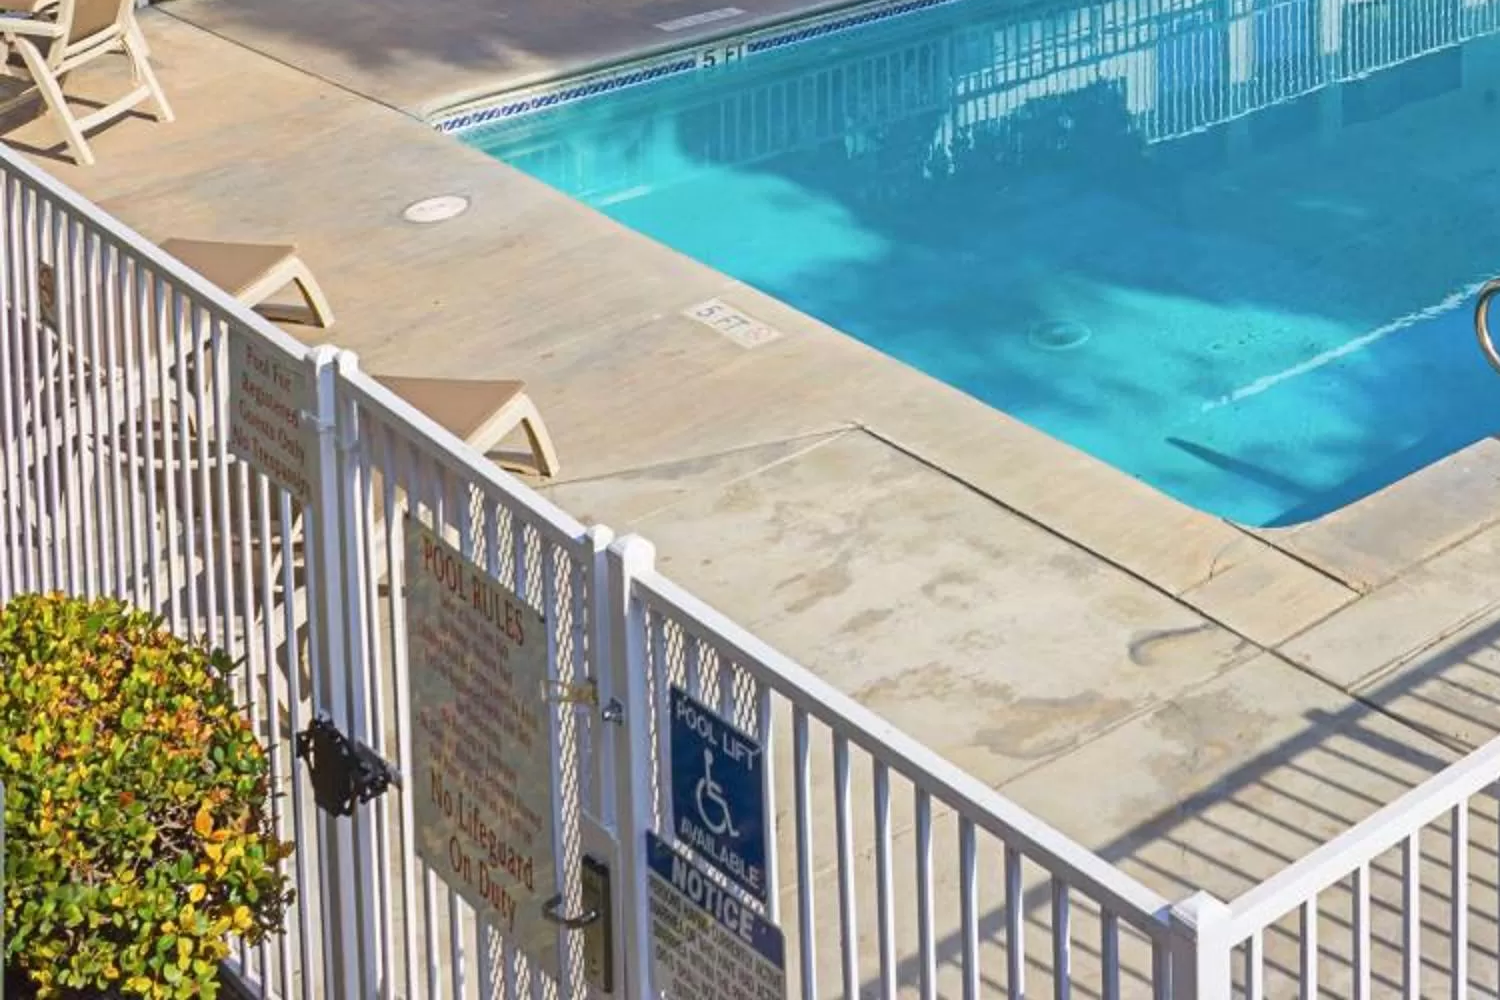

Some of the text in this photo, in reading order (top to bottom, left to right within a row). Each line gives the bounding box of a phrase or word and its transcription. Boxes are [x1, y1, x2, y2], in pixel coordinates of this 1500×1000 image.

[703, 48, 716, 68] 5
[695, 304, 724, 318] 5
[421, 533, 524, 647] POOL RULES
[676, 699, 762, 771] POOL LIFT
[431, 767, 535, 893] No Lifeguard
[680, 815, 760, 891] AVAILABLE
[450, 835, 516, 933] On Duty
[671, 855, 755, 943] NOTICE
